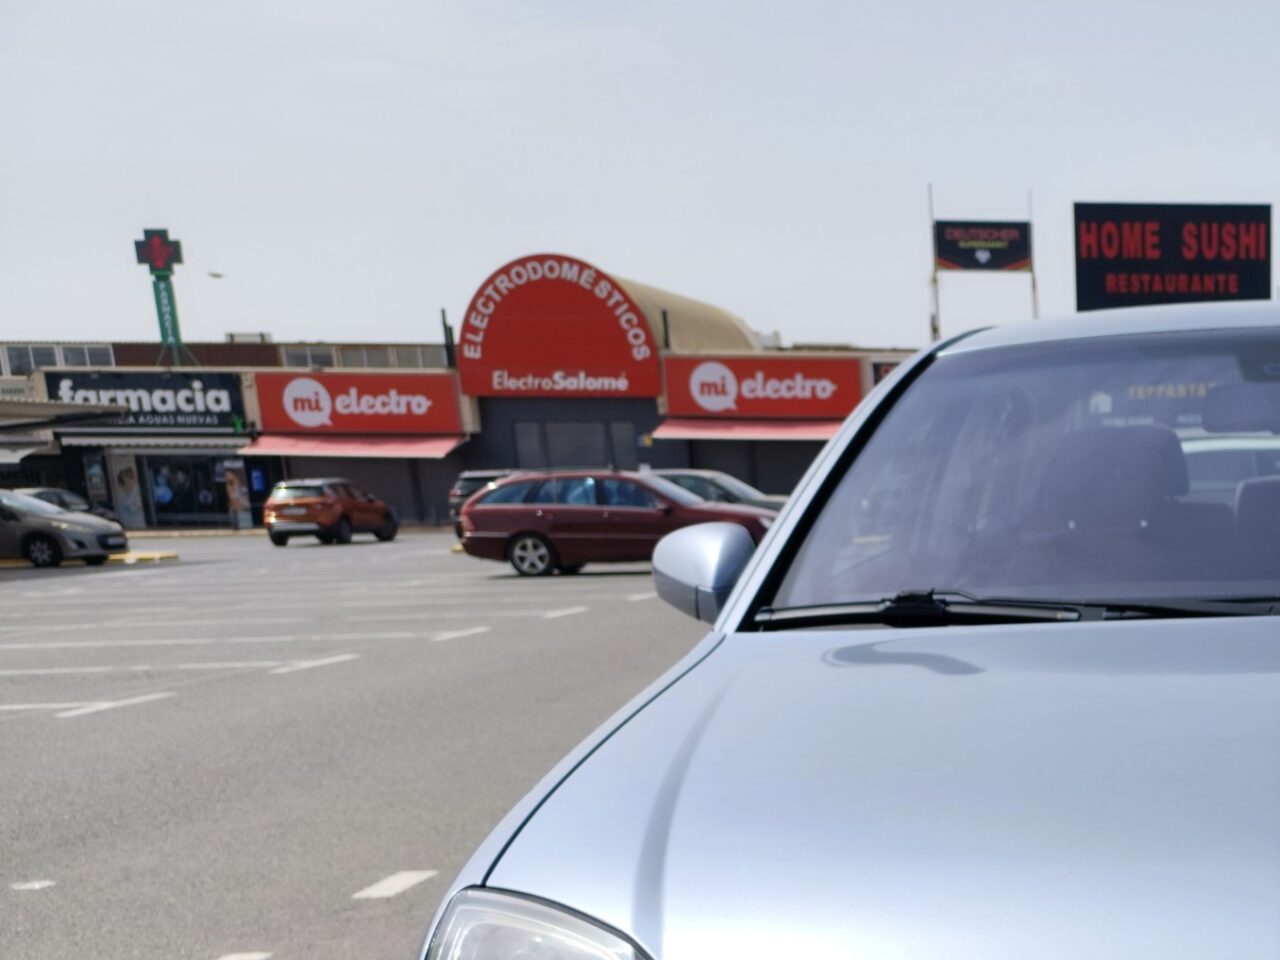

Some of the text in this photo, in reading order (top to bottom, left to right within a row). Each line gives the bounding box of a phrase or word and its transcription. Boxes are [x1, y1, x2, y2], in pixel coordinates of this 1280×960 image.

[1079, 221, 1267, 260] HOME SUSHI
[1106, 273, 1240, 295] RESTAURANTE
[463, 259, 651, 361] ELECTRODOMÉSTICOS
[492, 370, 629, 392] ElectroSalomé
[699, 371, 838, 399] mi electro
[58, 378, 232, 413] farmacia
[292, 387, 432, 415] mi electro
[138, 414, 175, 425] AGUAS
[176, 414, 219, 425] NUEVAS
